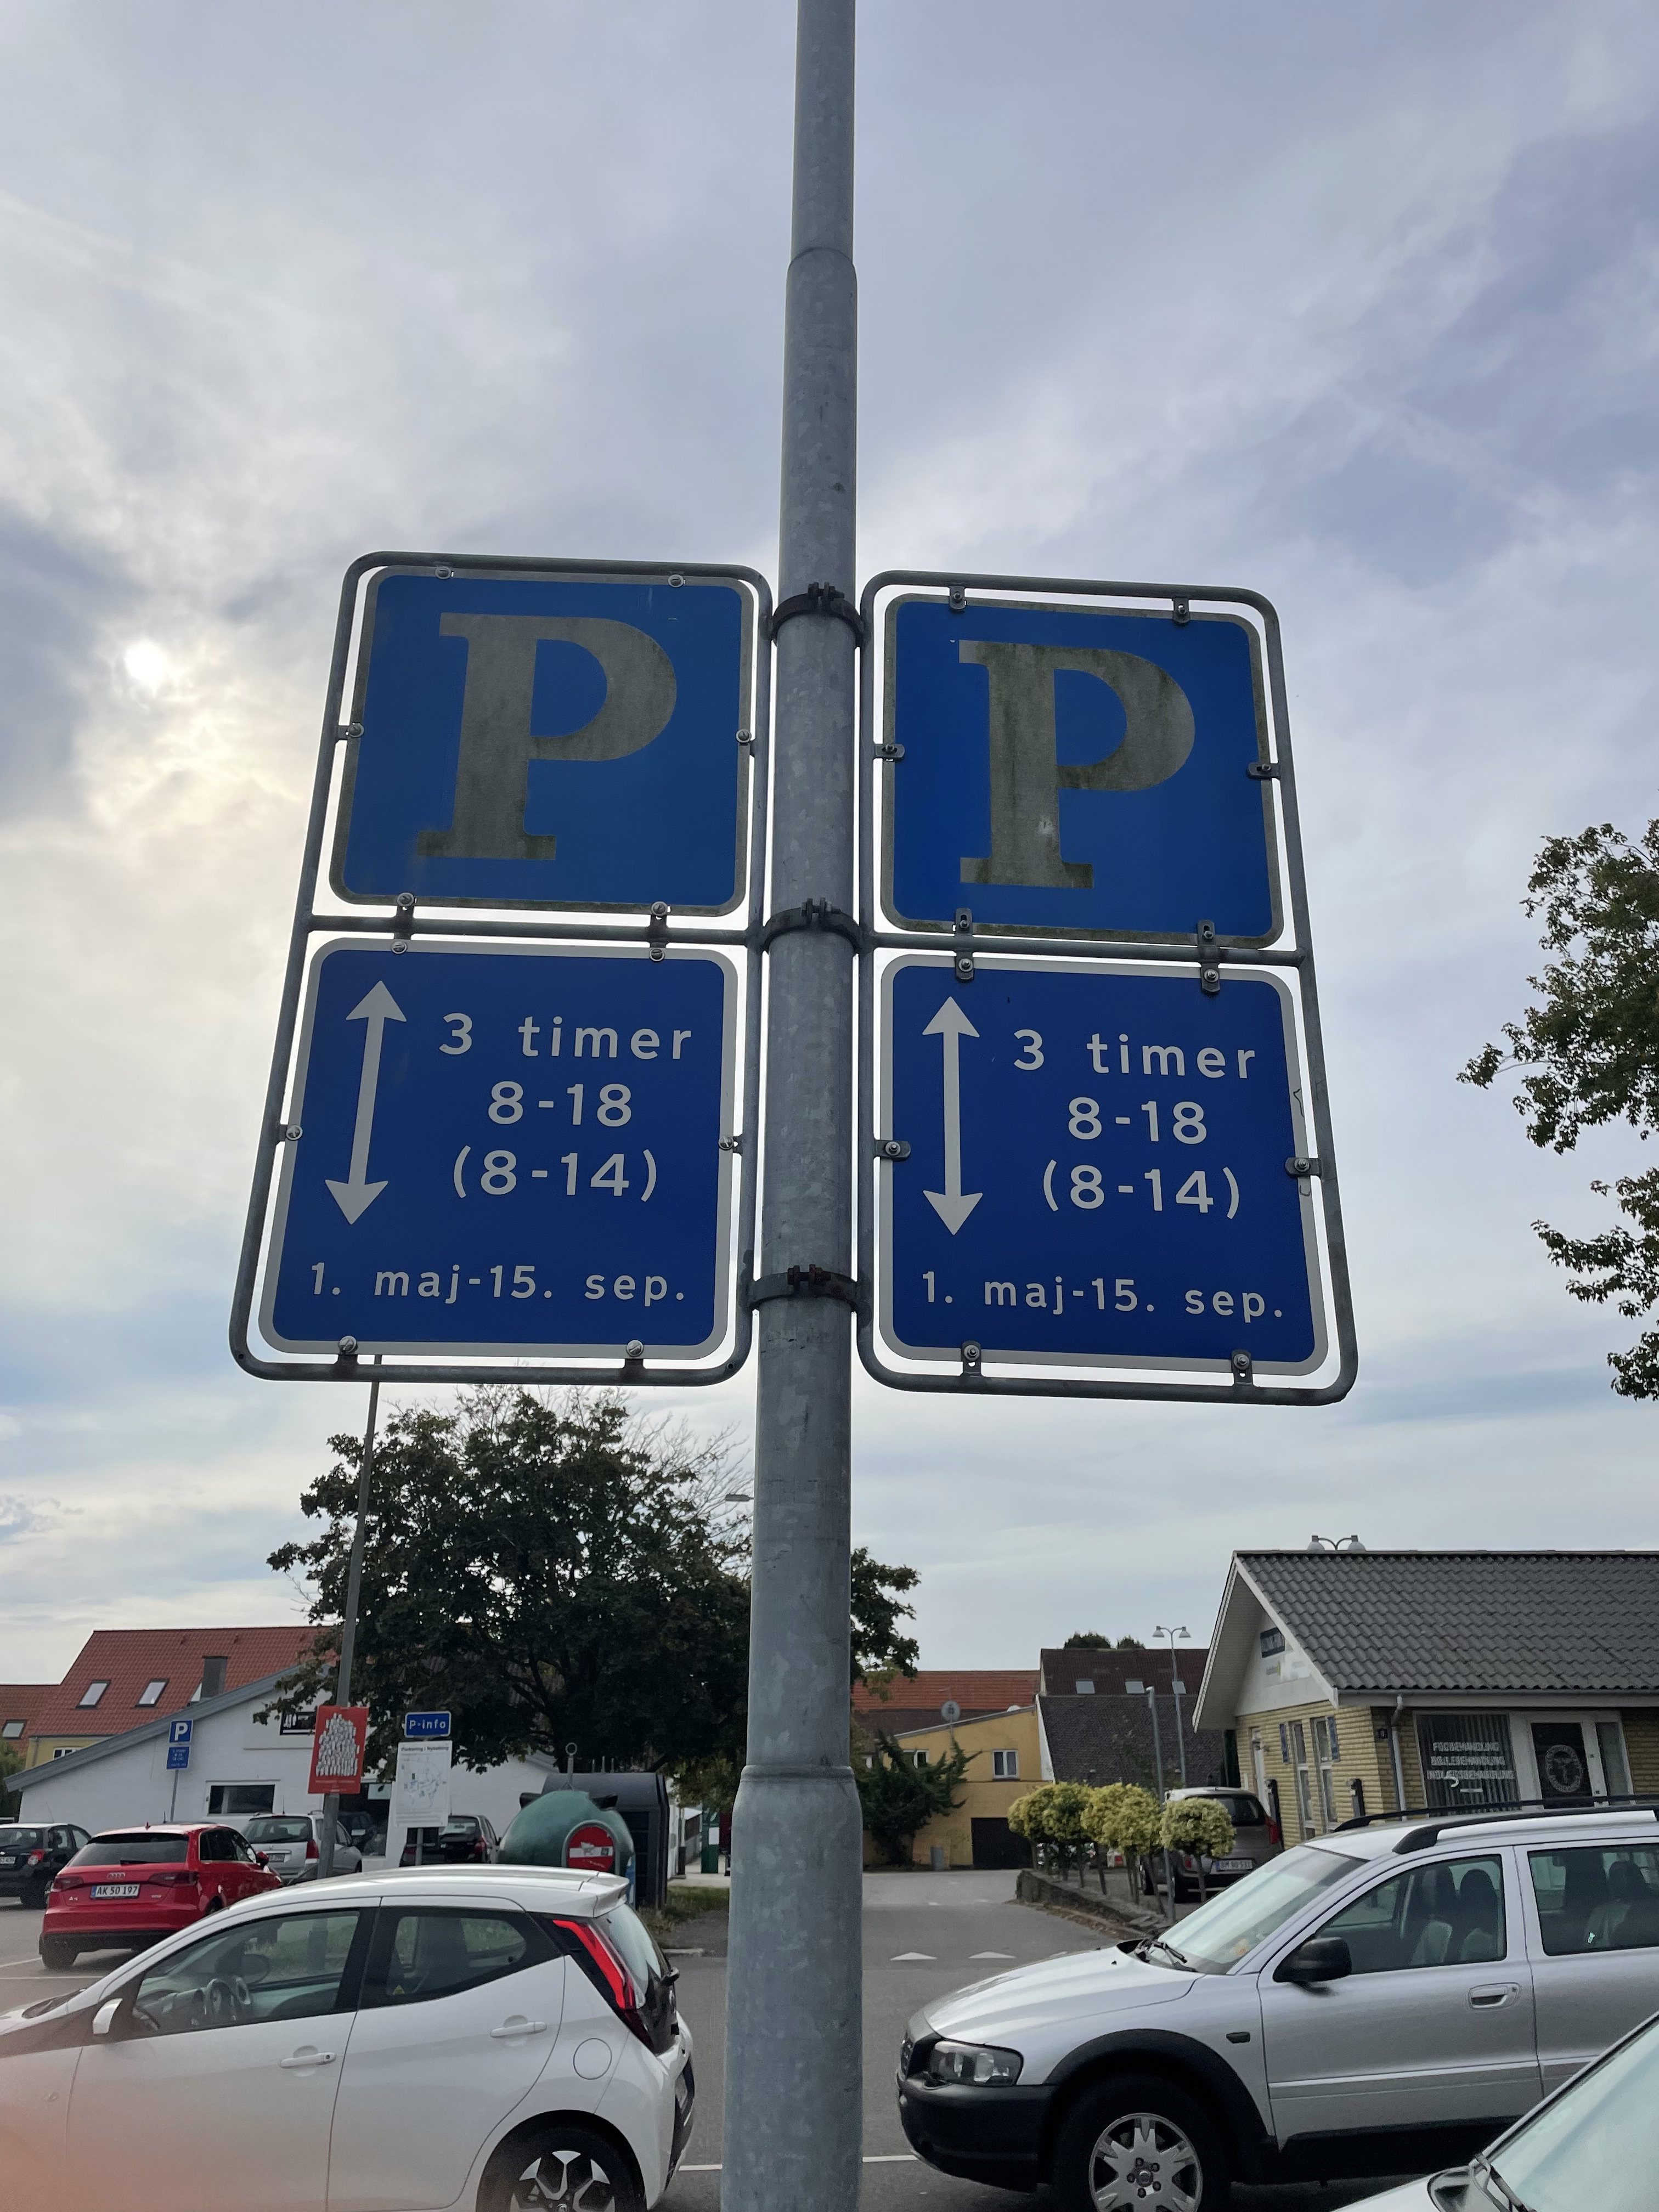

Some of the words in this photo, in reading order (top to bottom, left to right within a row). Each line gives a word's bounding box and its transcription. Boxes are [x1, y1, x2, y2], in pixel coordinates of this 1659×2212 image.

[417, 612, 677, 861] P
[958, 639, 1196, 889] P
[439, 1013, 472, 1055] 3
[518, 1016, 691, 1059] timer
[1014, 1029, 1044, 1070] 3
[1086, 1033, 1255, 1079] timer
[488, 1081, 631, 1127] 8-18
[1068, 1097, 1207, 1144] 8-18
[454, 1145, 657, 1202] (8-14)
[1043, 1159, 1239, 1220] (8-14)
[312, 1262, 340, 1295] 1.
[374, 1265, 552, 1304] maj-15.
[584, 1274, 684, 1307] sep.
[922, 1271, 953, 1304] 1.
[985, 1278, 1154, 1315] maj-15.
[1185, 1290, 1284, 1323] sep.
[174, 1722, 188, 1741] P
[409, 1719, 446, 1730] P-info
[97, 1887, 108, 1895] AK
[110, 1886, 120, 1895] 50
[122, 1886, 138, 1895] 197
